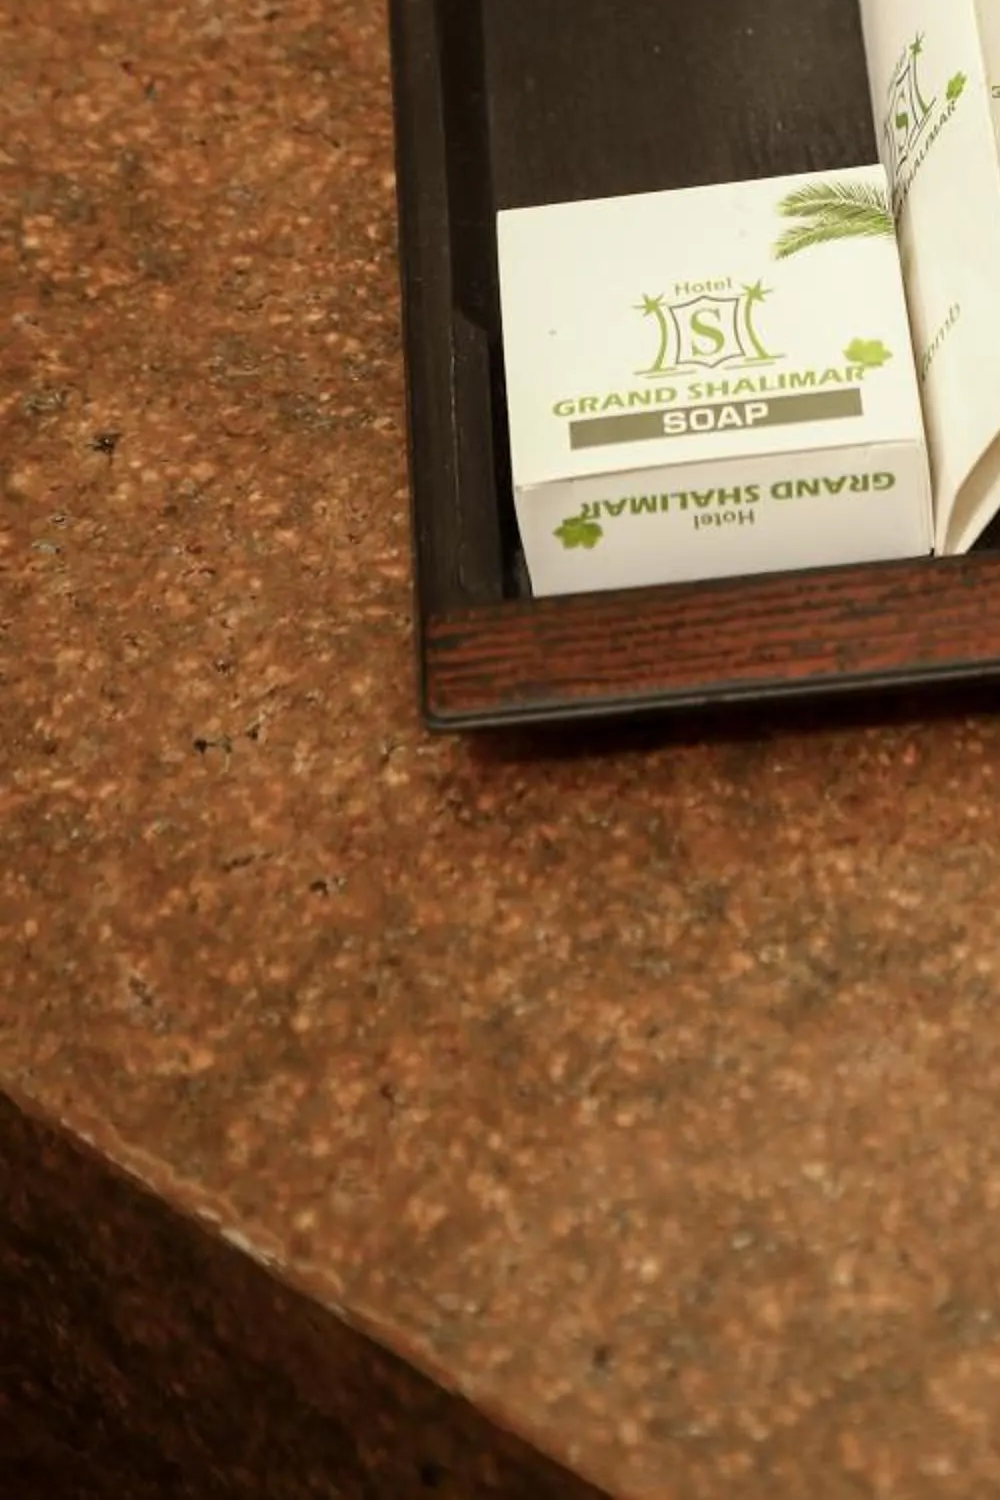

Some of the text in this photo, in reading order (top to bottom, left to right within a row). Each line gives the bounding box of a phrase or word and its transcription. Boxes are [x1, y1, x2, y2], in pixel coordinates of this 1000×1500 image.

[674, 277, 732, 297] Hotel
[690, 307, 726, 357] S
[552, 365, 865, 418] GRAND SHALIMAR
[663, 401, 769, 434] SOAP
[580, 471, 896, 520] GRAND SHALIMAR
[693, 508, 755, 531] Hotel
